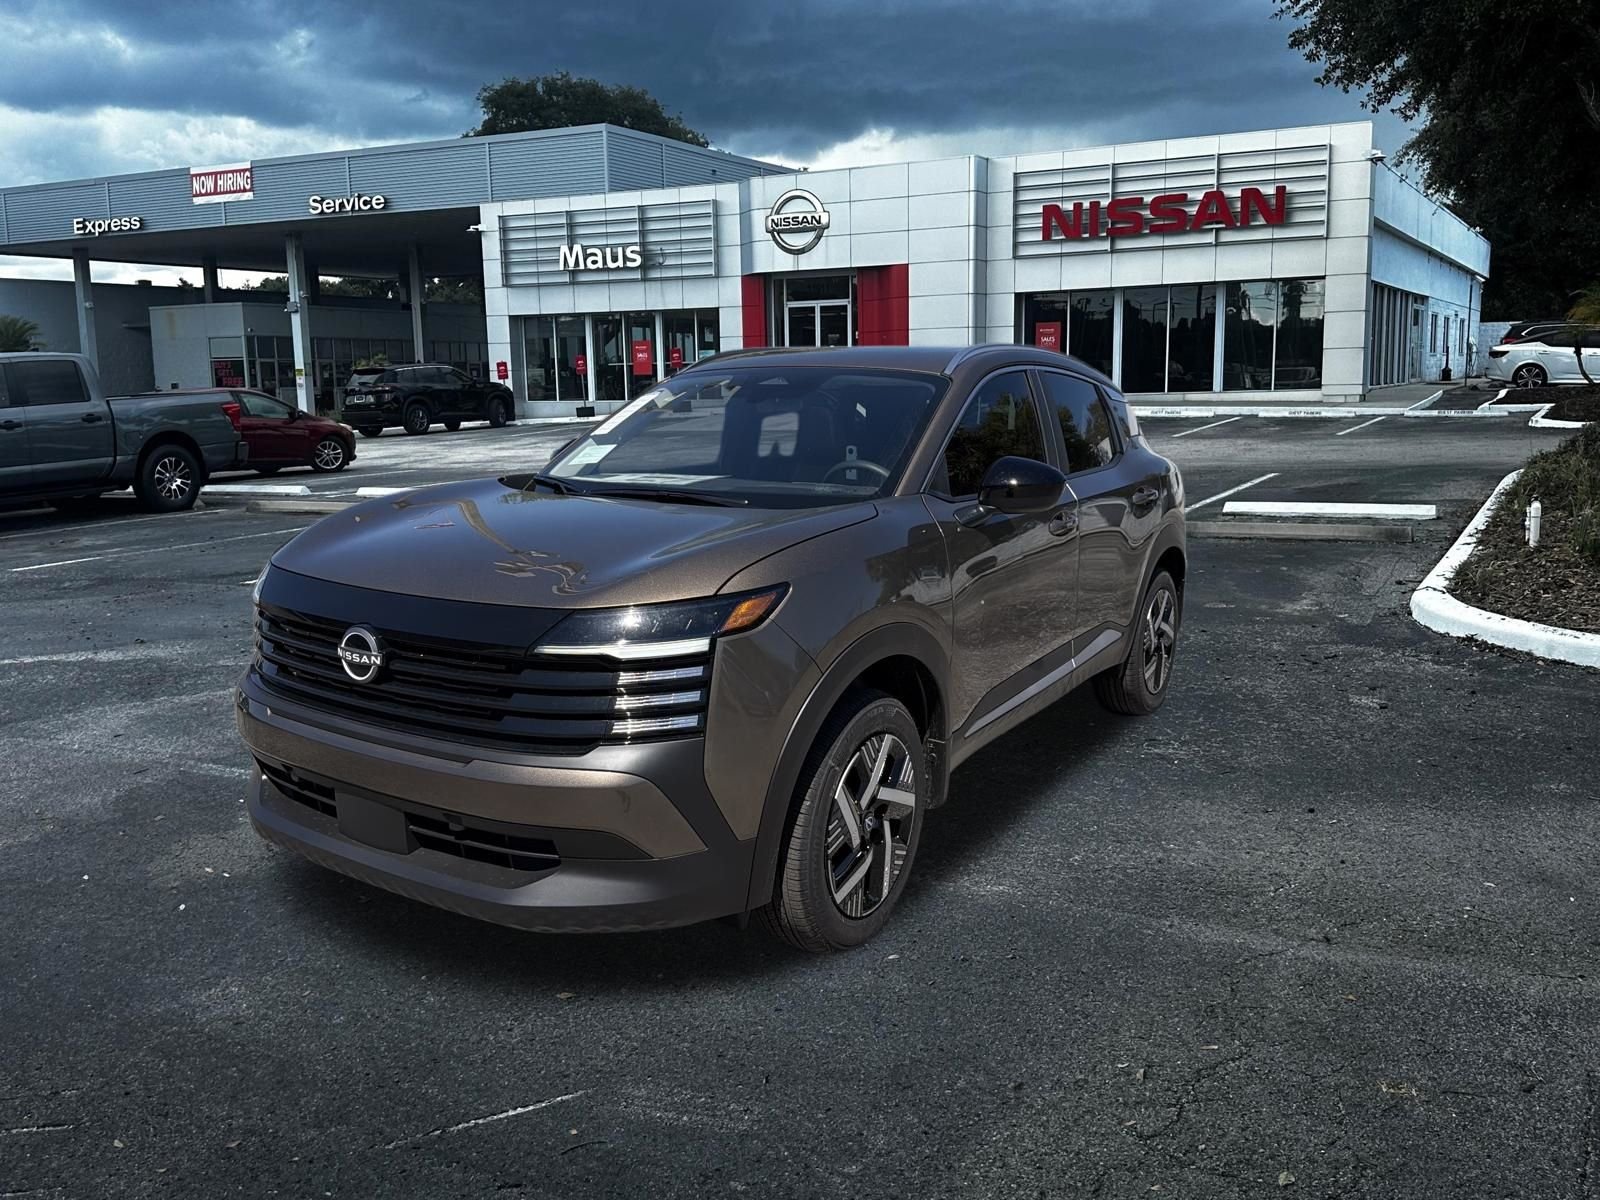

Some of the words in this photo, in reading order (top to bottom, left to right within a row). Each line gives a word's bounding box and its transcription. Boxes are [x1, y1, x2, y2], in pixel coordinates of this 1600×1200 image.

[192, 174, 215, 195] NOW
[217, 171, 251, 192] HIRING
[309, 193, 385, 214] Service
[1041, 185, 1287, 241] NISSAN
[73, 216, 141, 236] Express
[770, 215, 822, 228] NISSAN
[559, 243, 642, 271] Maus
[338, 647, 381, 665] NISSAN
